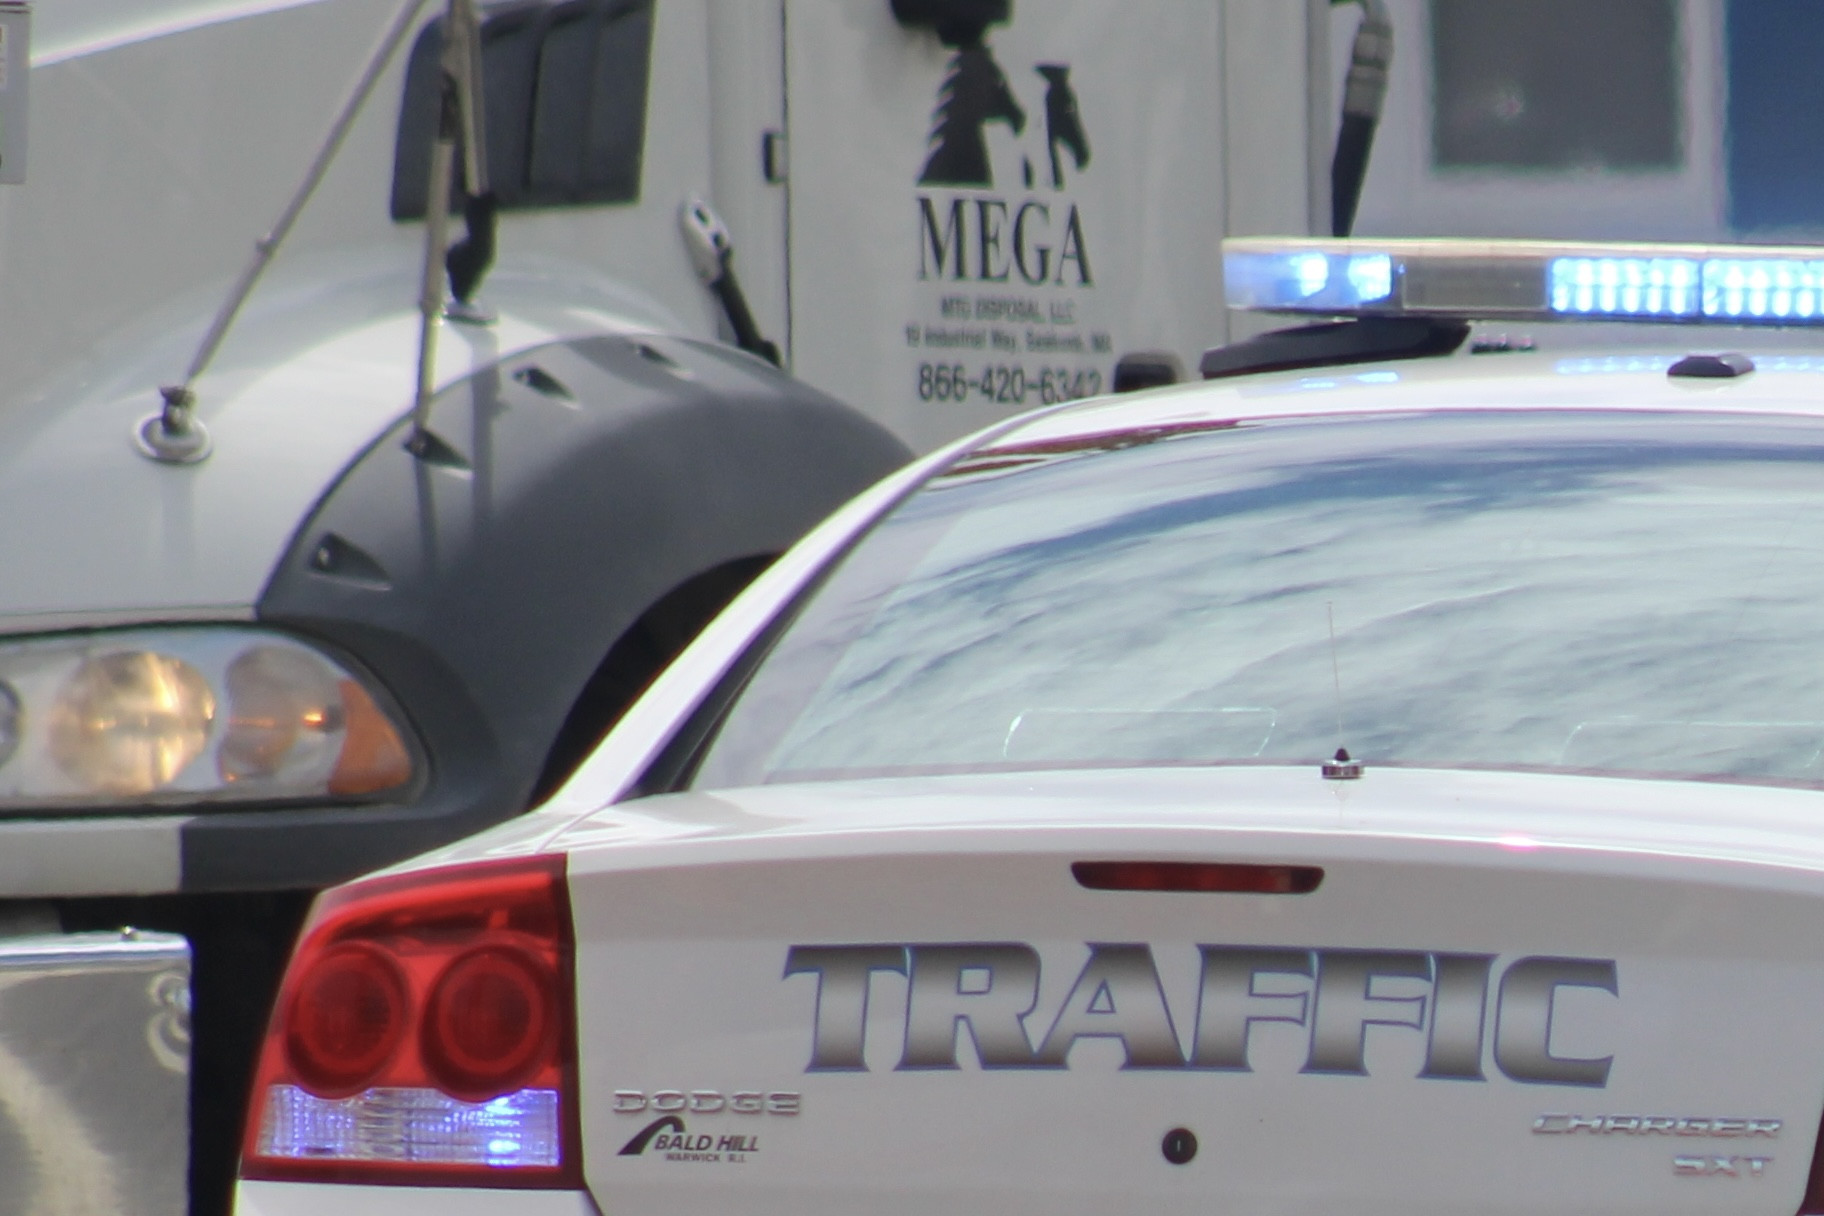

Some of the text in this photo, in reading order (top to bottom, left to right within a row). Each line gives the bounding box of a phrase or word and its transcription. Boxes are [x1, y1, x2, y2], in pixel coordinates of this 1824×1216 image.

[916, 198, 1093, 287] MEGA
[783, 941, 1620, 1089] TRAFFIC
[612, 1090, 801, 1115] DODGE
[1531, 1113, 1783, 1139] CHARGER
[655, 1134, 759, 1152] BALD HILL
[665, 1152, 720, 1163] WARWICK
[1673, 1154, 1774, 1179] SXT
